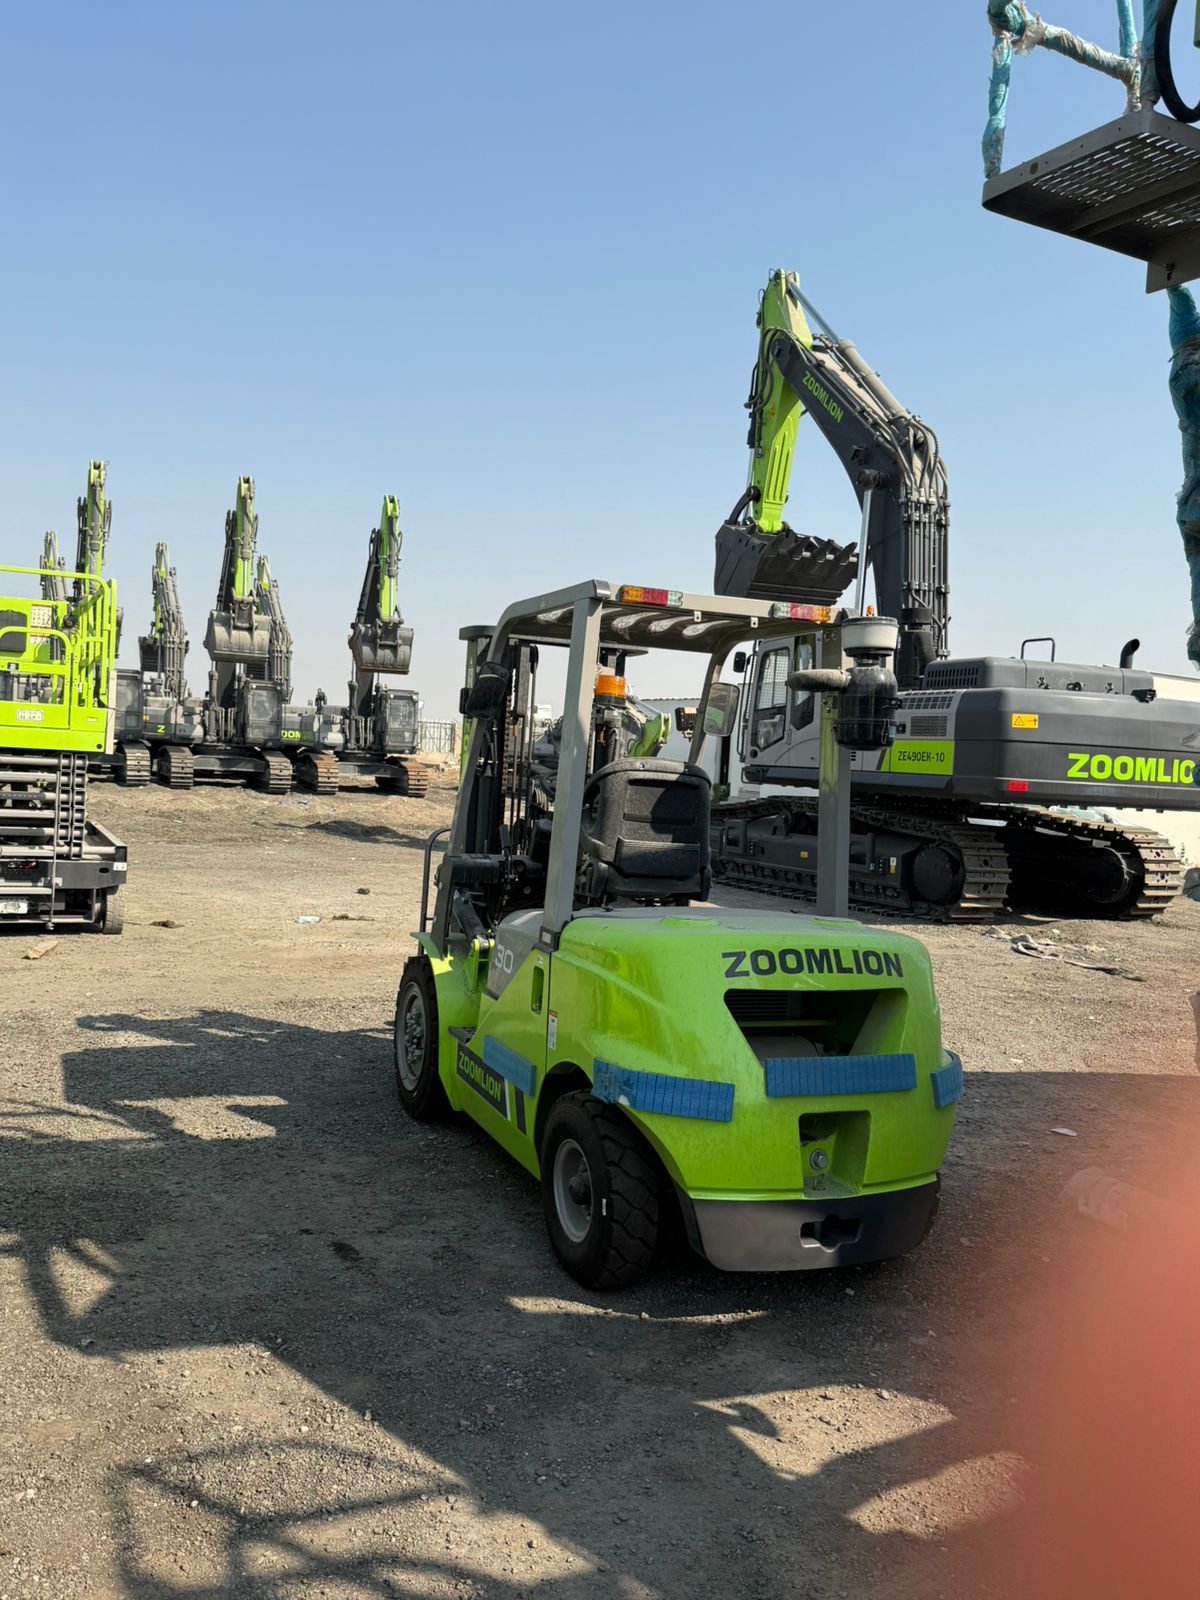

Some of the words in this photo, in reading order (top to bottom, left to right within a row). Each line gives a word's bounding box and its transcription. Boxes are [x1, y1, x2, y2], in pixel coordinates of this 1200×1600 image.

[802, 370, 844, 423] ZOOMLION
[495, 944, 514, 974] 30
[721, 948, 904, 978] ZOOMLION
[459, 1051, 501, 1102] ZOOMLION
